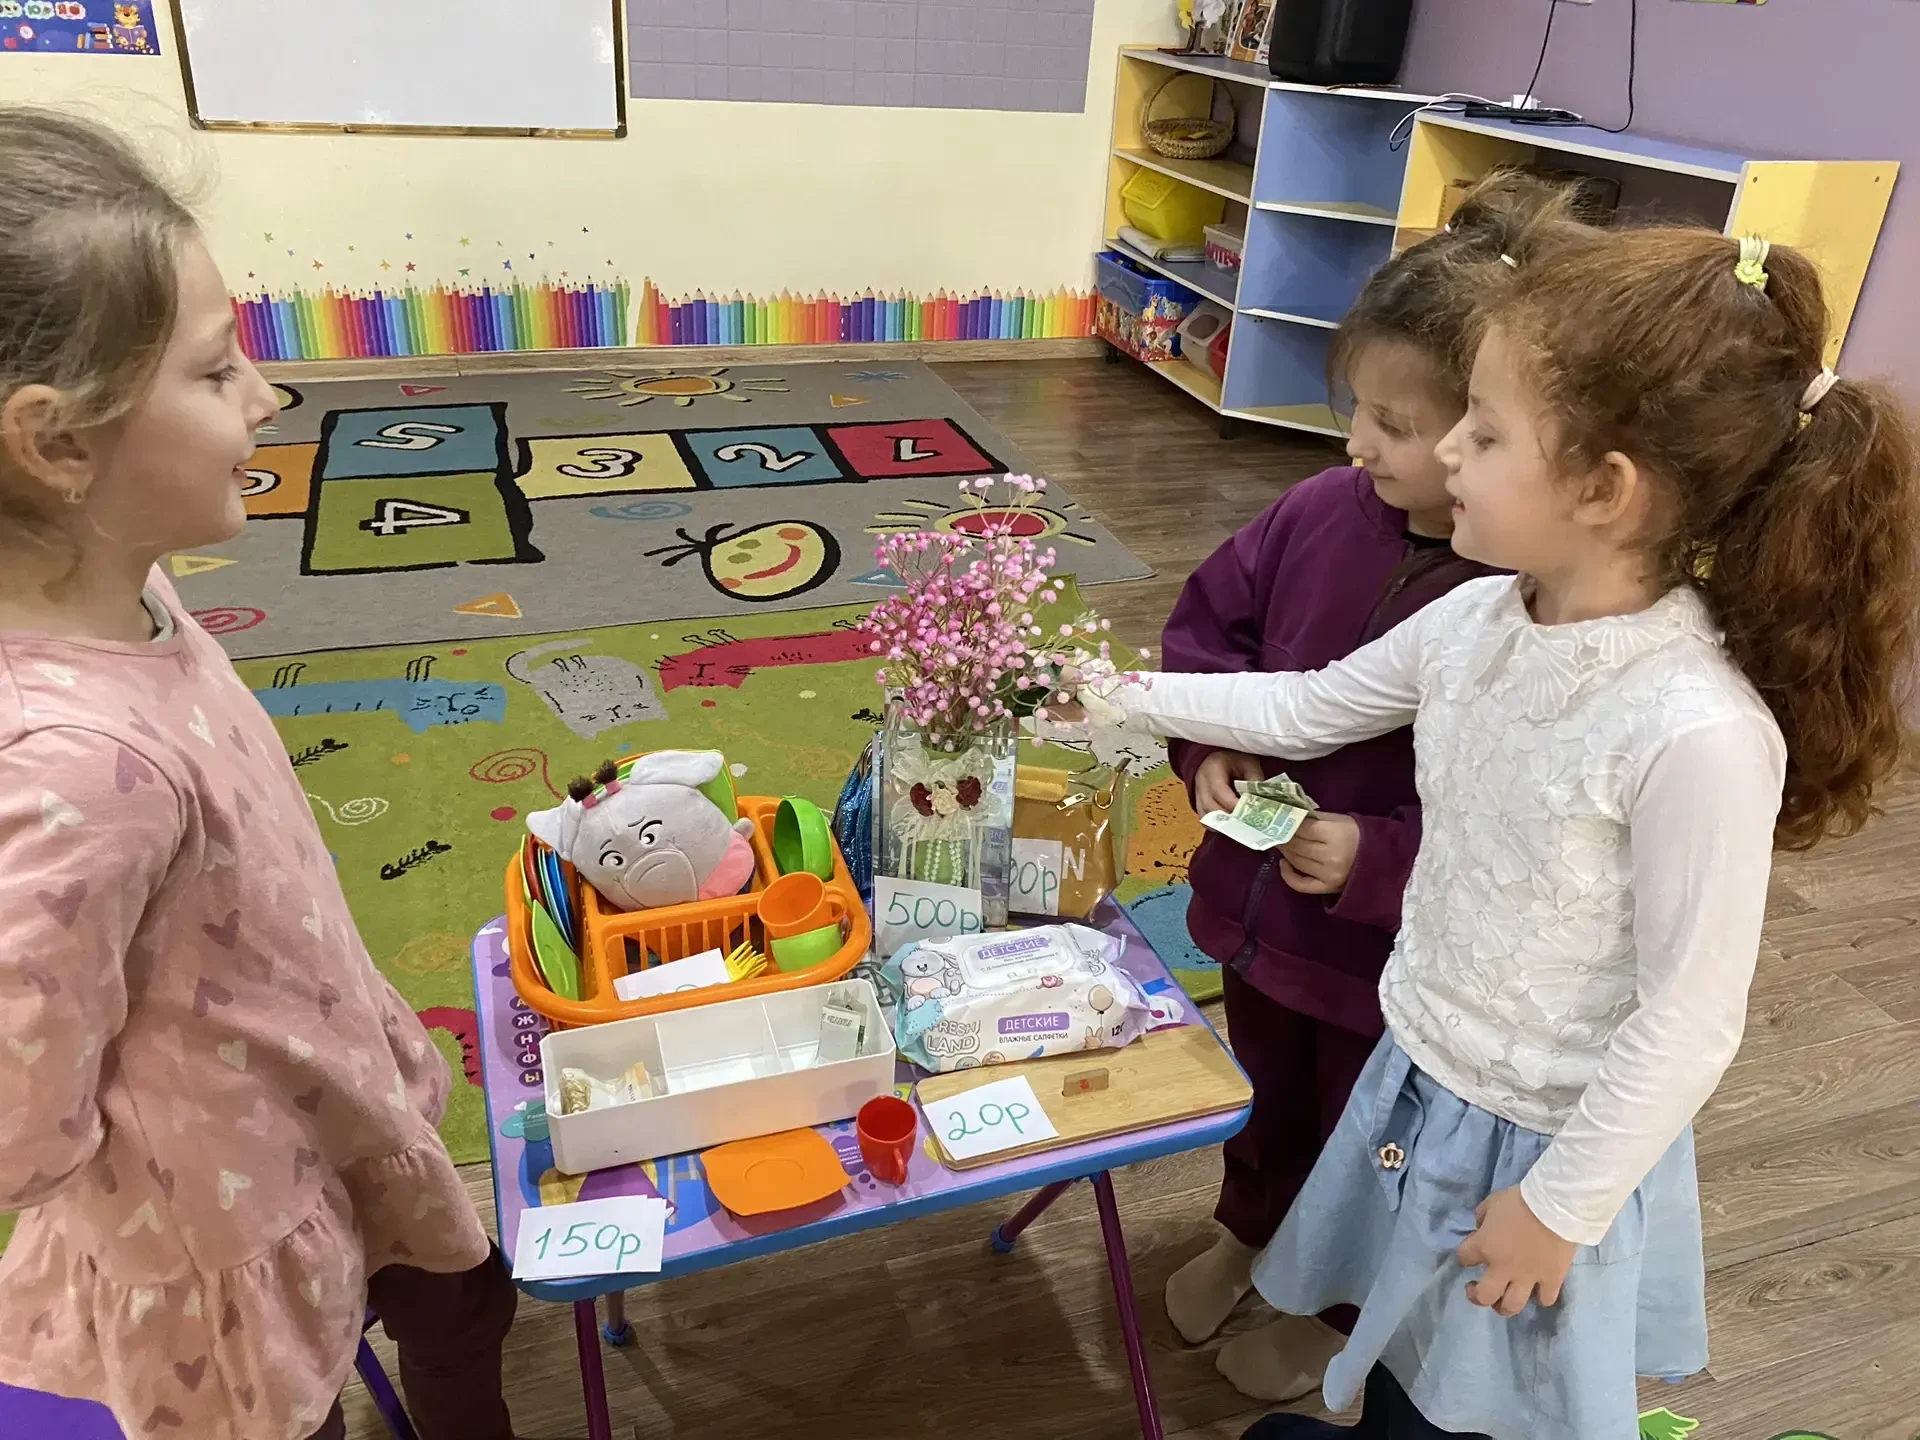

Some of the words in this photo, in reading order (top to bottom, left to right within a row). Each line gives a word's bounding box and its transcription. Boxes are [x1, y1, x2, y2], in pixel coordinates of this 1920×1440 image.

[352, 421, 464, 450] 5
[713, 442, 815, 472] 2
[885, 436, 942, 462] 1
[556, 448, 643, 478] 3
[359, 498, 470, 536] 4
[885, 891, 980, 934] 500р
[980, 939, 1044, 960] ДЕТСКИЕ
[517, 1014, 535, 1027] Ж
[1004, 1015, 1060, 1032] ДЕТСКИЕ
[926, 1034, 975, 1053] LAND
[998, 1035, 1031, 1044] ВЛАЖНЫЕ
[1033, 1032, 1069, 1043] САЛФЕТКИ
[522, 1045, 537, 1064] Ф
[524, 1071, 541, 1083] Ы
[535, 1221, 641, 1270] 150р
